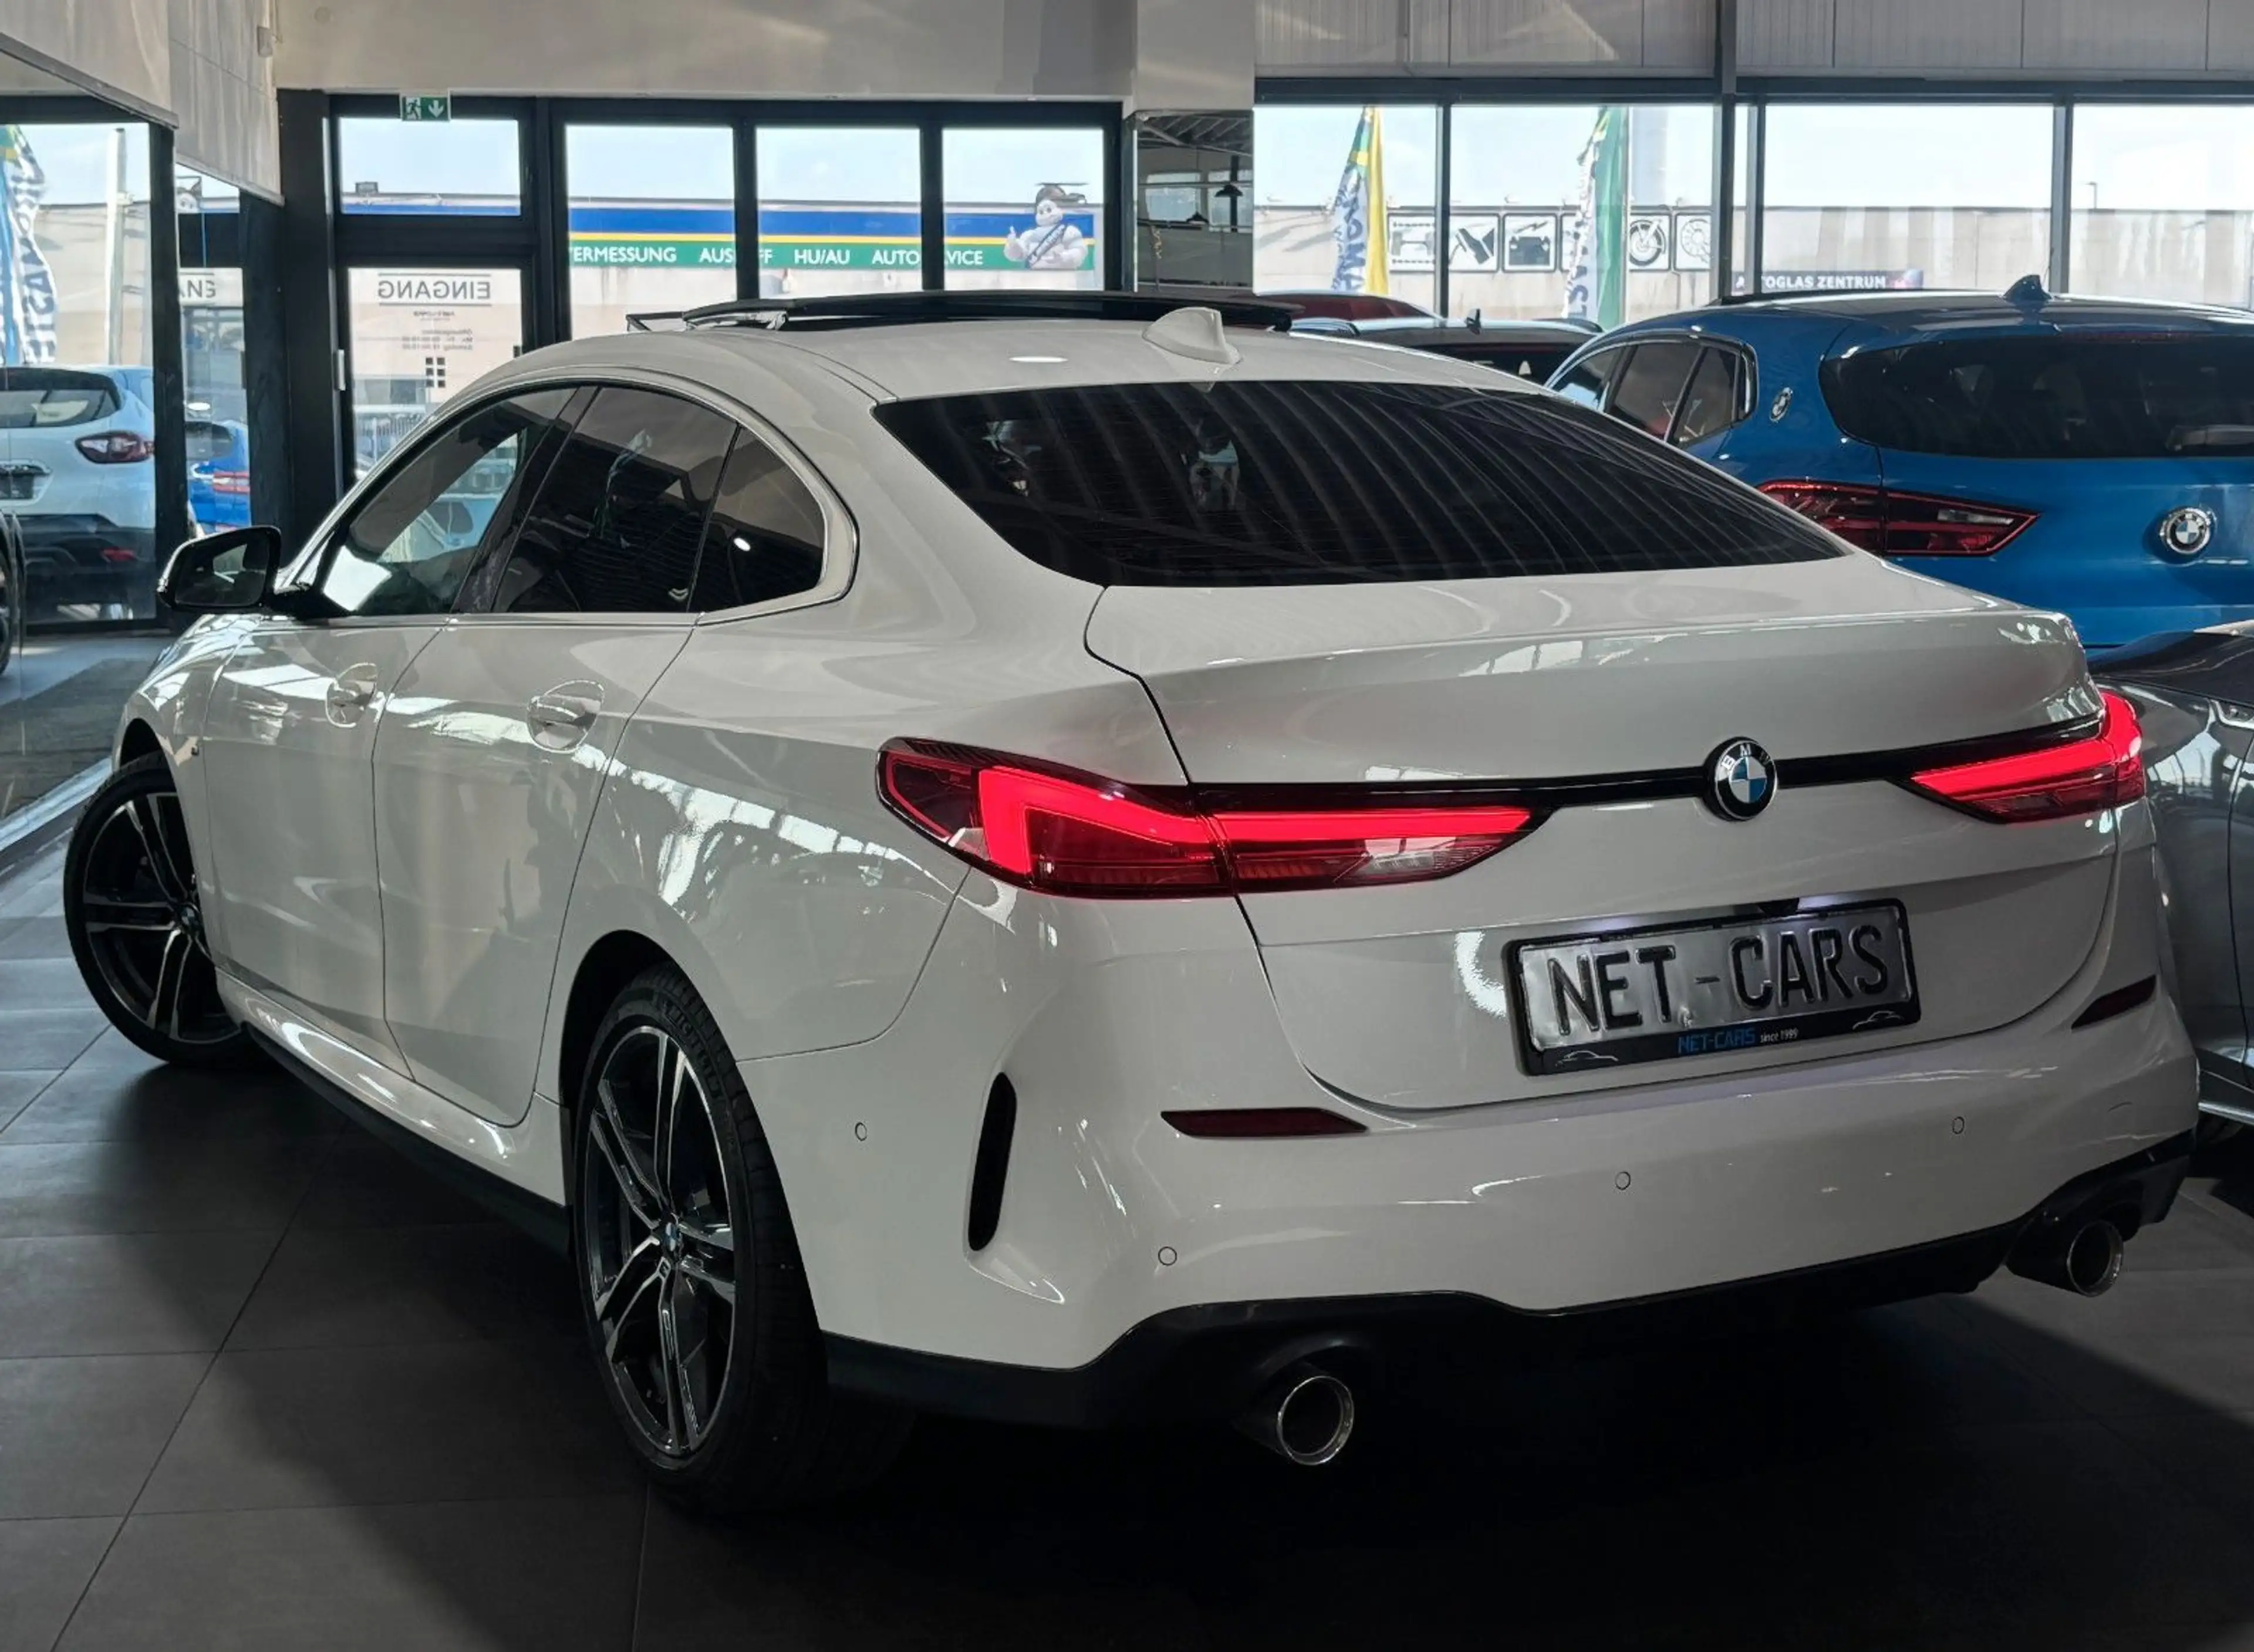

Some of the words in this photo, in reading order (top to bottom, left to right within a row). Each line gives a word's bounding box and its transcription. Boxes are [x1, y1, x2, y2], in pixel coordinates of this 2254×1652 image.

[569, 246, 676, 263] ERMESSUNG
[794, 249, 851, 265] HU/AU
[1817, 275, 1886, 289] ZENTRUM
[1547, 945, 1676, 1036] NET
[1729, 925, 1888, 1011] CARS
[1678, 1028, 1756, 1054] NET-CARS
